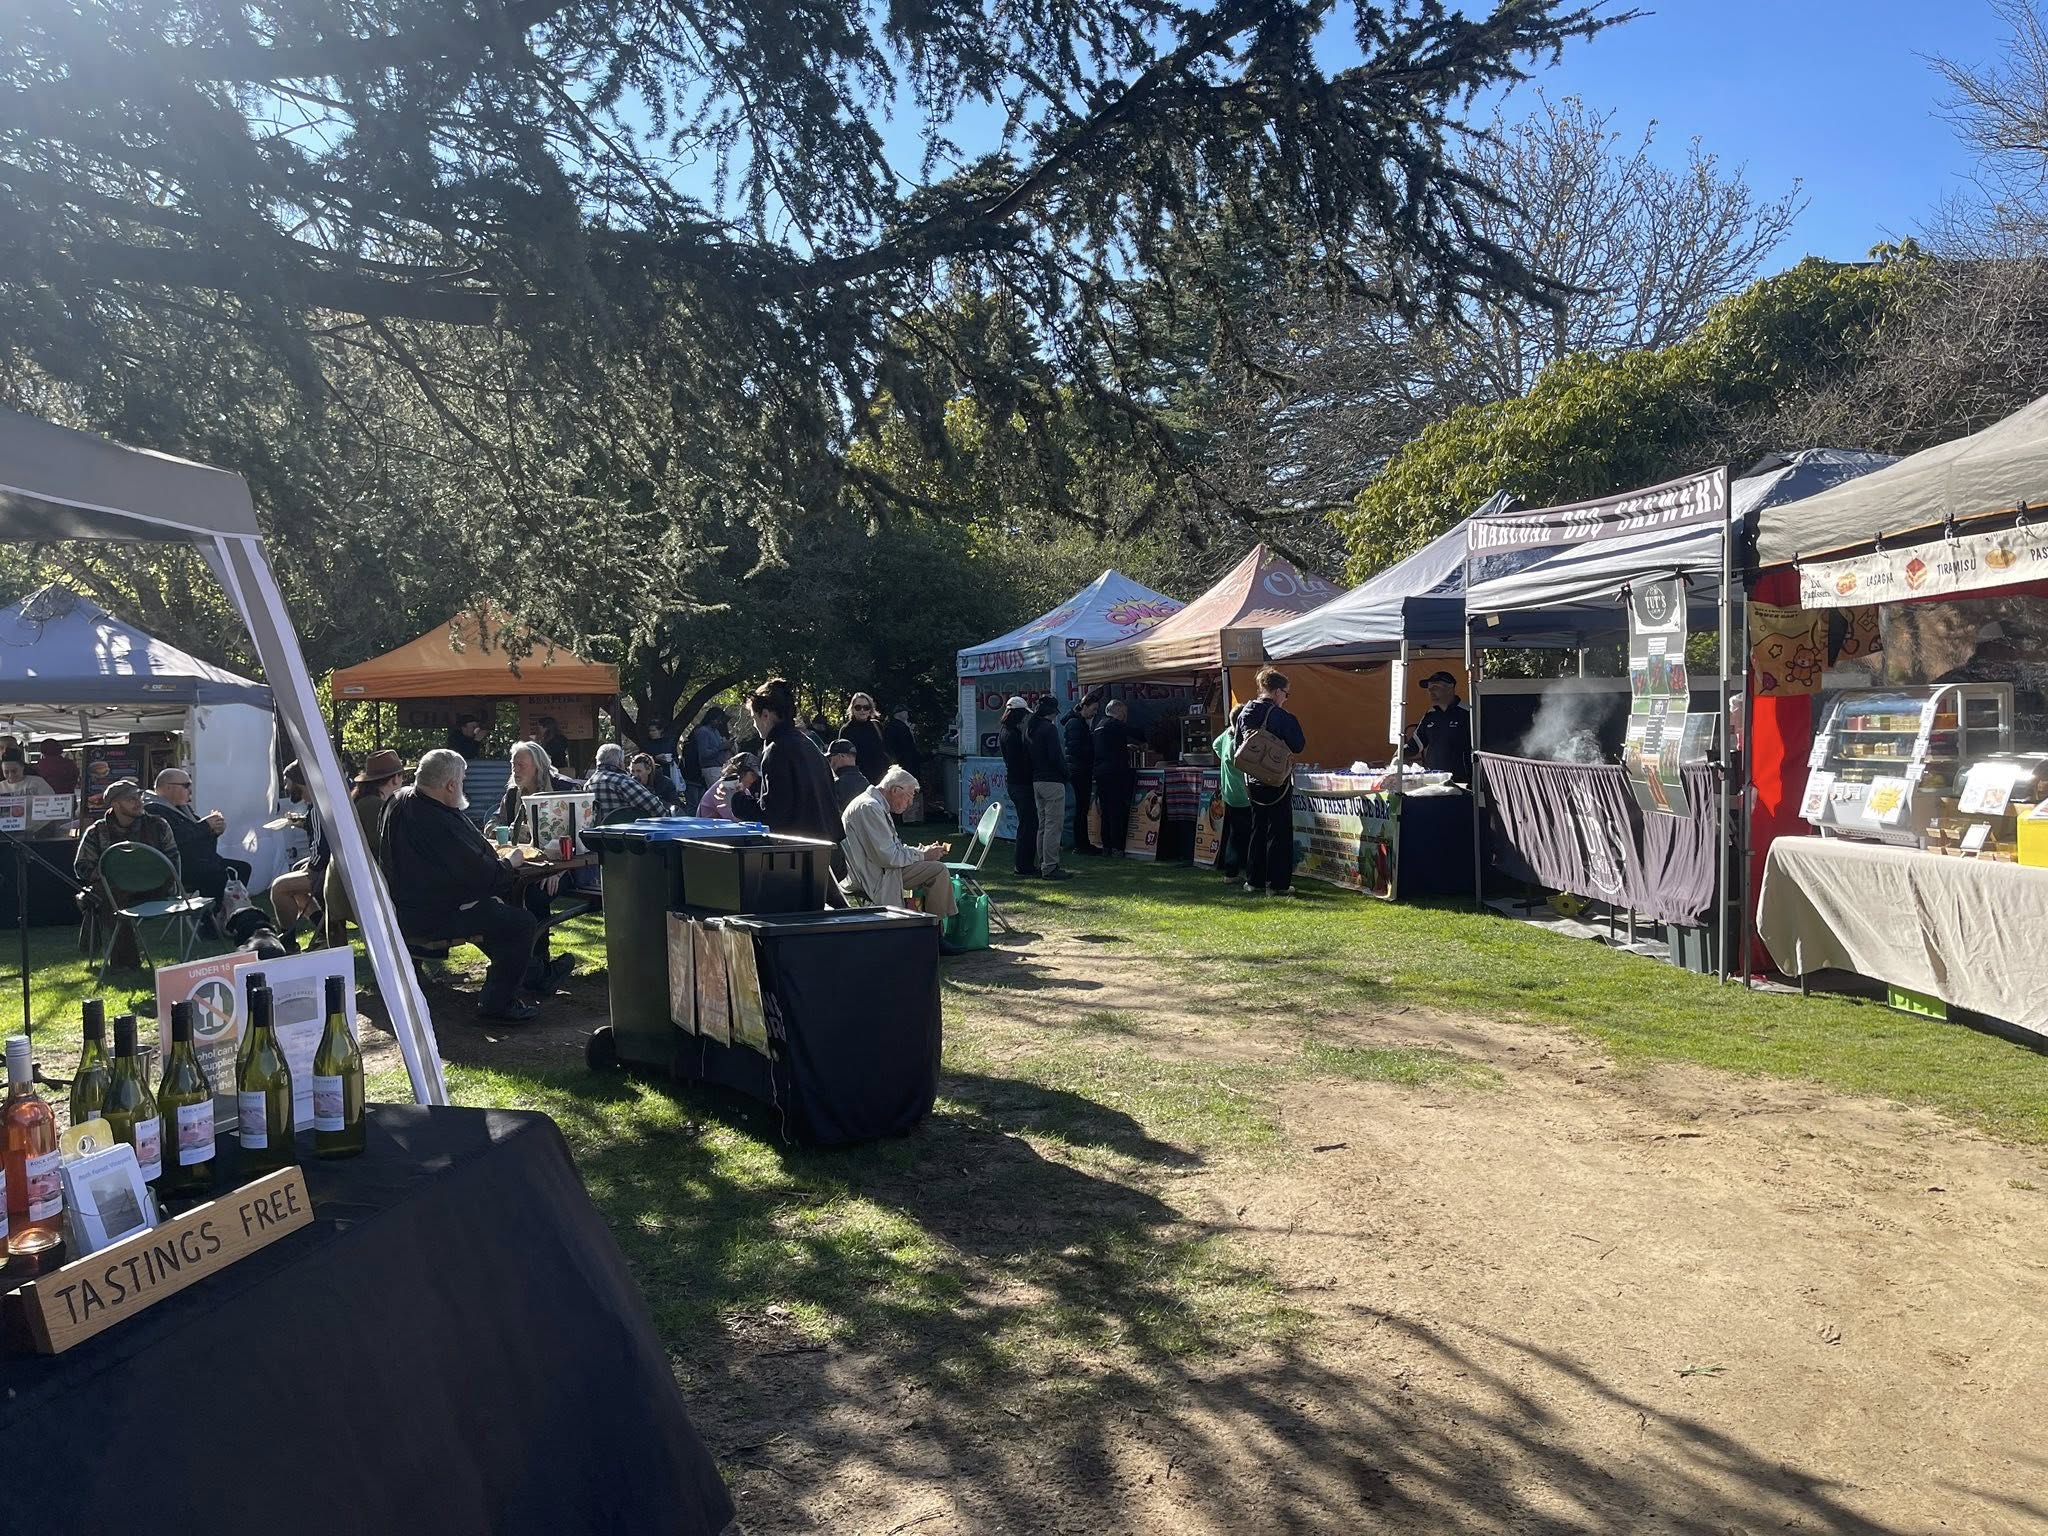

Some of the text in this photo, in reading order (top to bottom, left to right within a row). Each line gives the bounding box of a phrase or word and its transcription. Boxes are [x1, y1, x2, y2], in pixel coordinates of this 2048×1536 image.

[1468, 468, 1725, 550] CHARCOAL BBQ SKEWERS
[2030, 546, 2048, 561] PAS
[1937, 558, 1977, 577] TIRAMISU
[1866, 572, 1895, 587] LASAGNA
[1308, 796, 1322, 814] AND
[1324, 797, 1348, 816] FRESH
[1349, 797, 1374, 818] JUICE
[189, 963, 219, 978] UNDER
[54, 1182, 302, 1325] TASTINGS FREE
